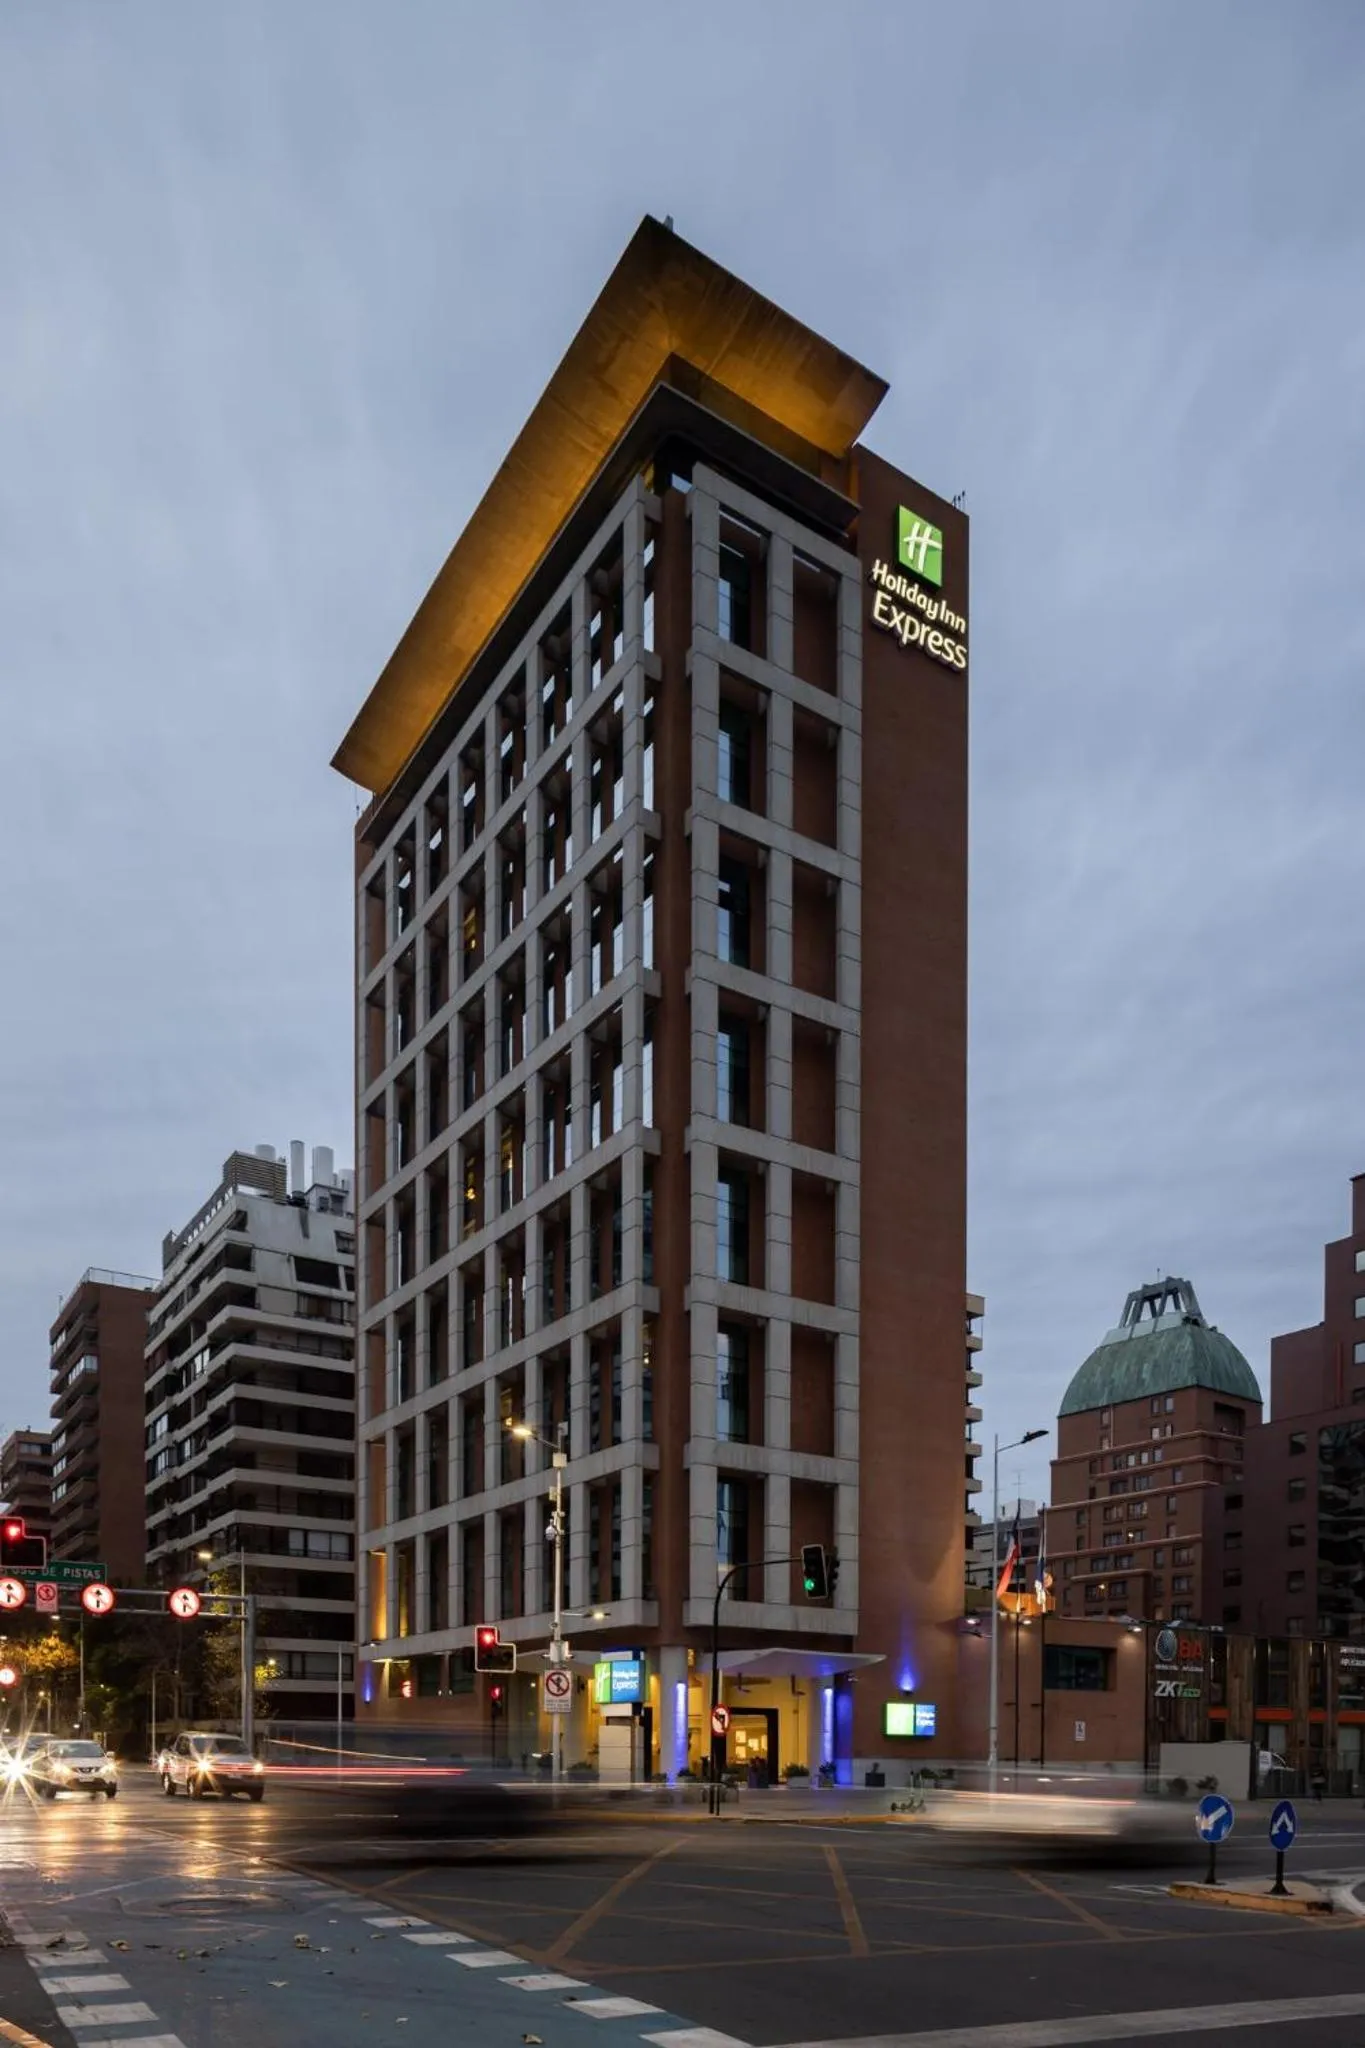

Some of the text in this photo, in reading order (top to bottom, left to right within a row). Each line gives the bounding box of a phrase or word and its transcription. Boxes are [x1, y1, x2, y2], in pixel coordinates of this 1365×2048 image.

[872, 558, 967, 634] Holiday Inn
[873, 589, 967, 669] Express
[63, 1567, 101, 1579] PISTAS
